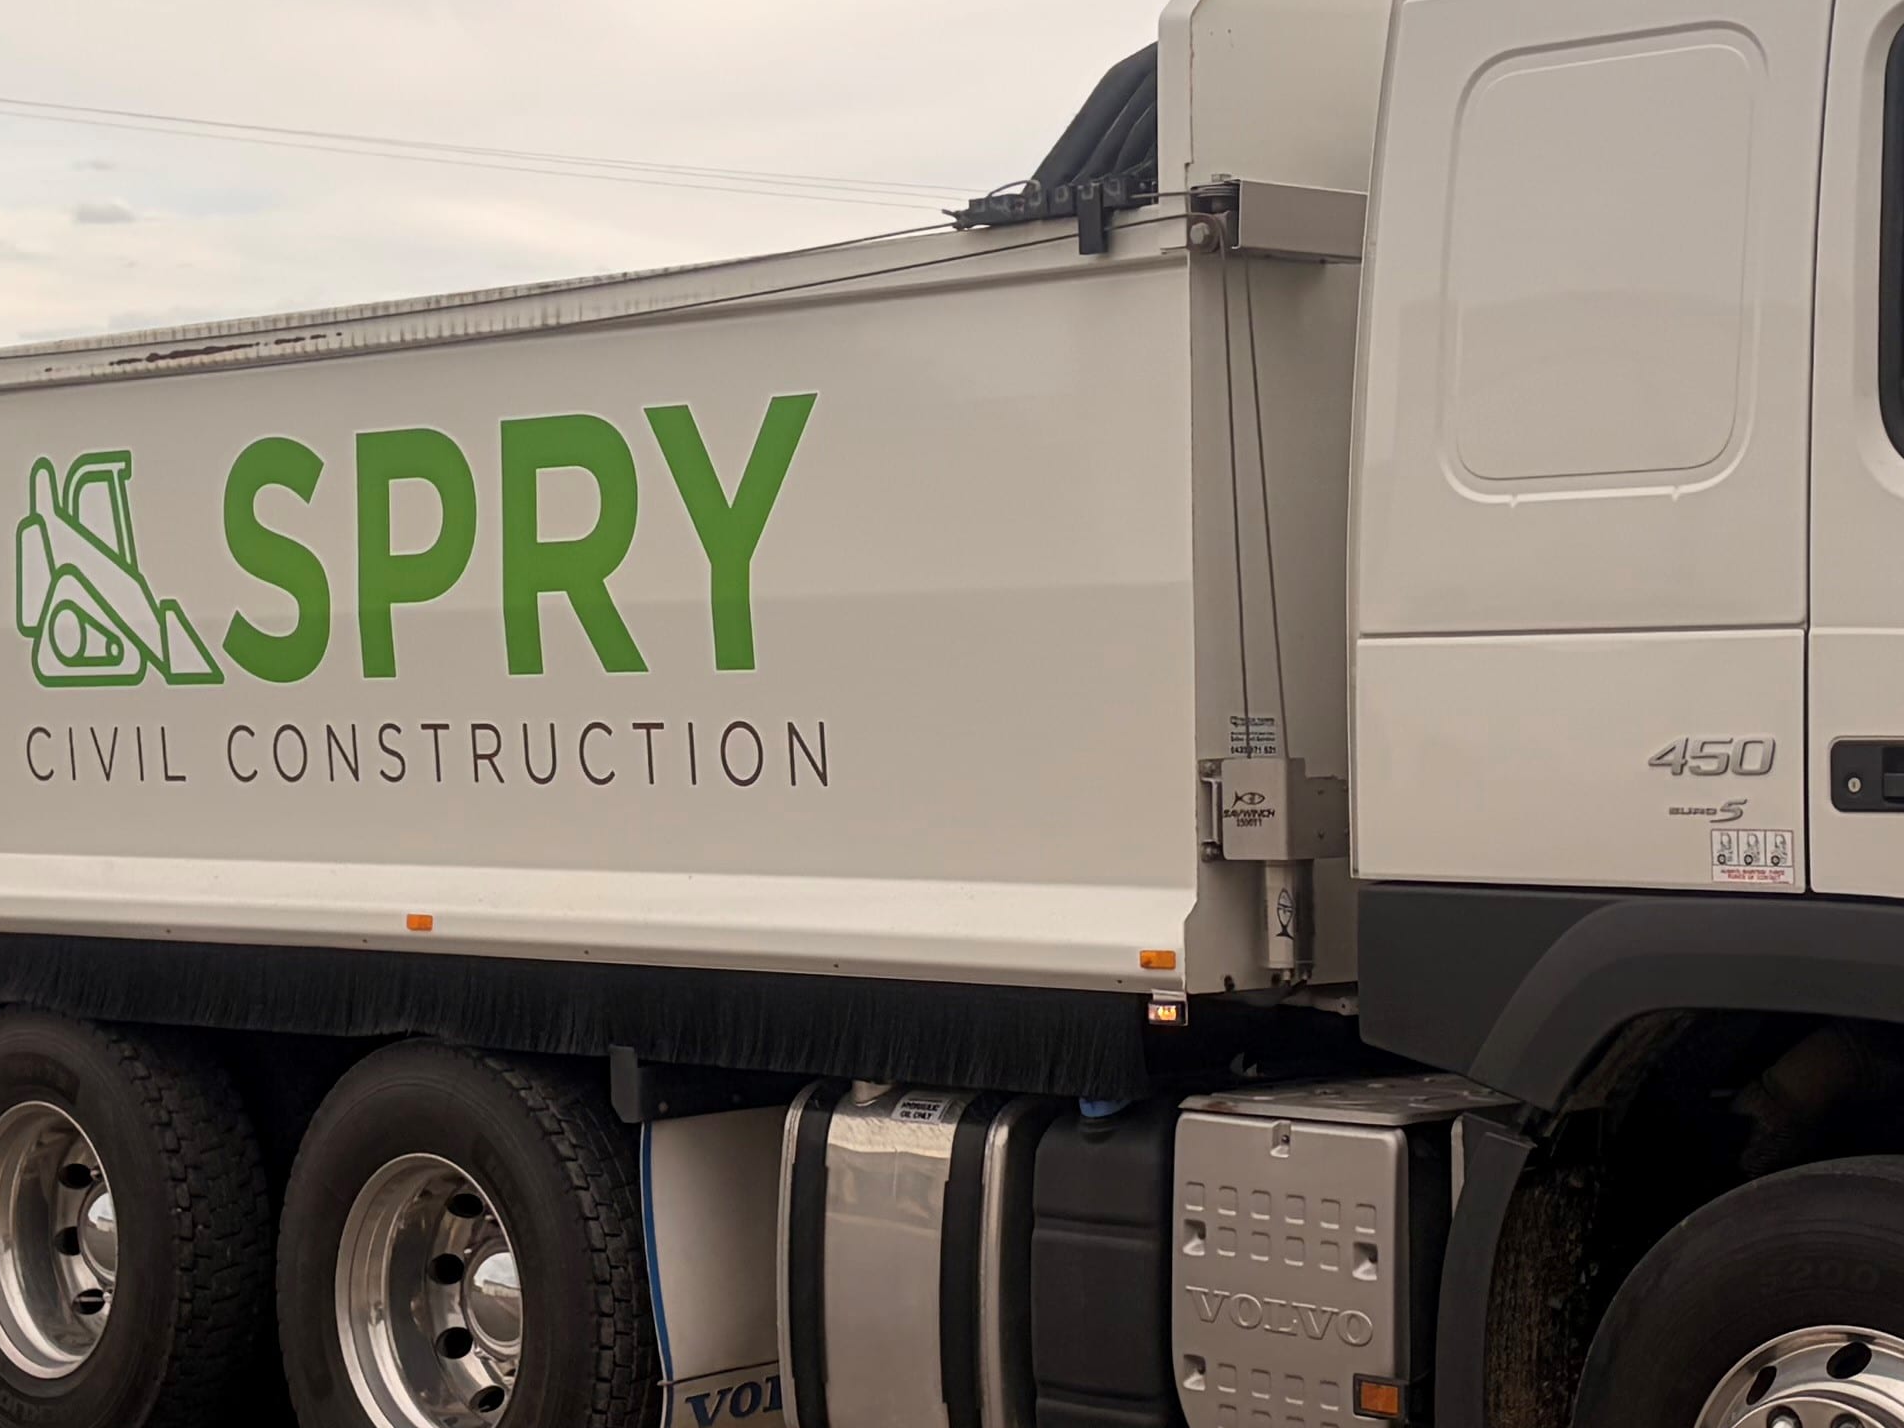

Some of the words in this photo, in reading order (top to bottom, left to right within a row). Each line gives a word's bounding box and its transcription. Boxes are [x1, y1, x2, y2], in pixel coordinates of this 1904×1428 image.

[223, 393, 818, 683] SPRY
[26, 725, 187, 782] CIVIL
[227, 720, 831, 788] CONSTRUCTION
[1648, 736, 1776, 776] 450
[1184, 1284, 1374, 1347] VOLVO
